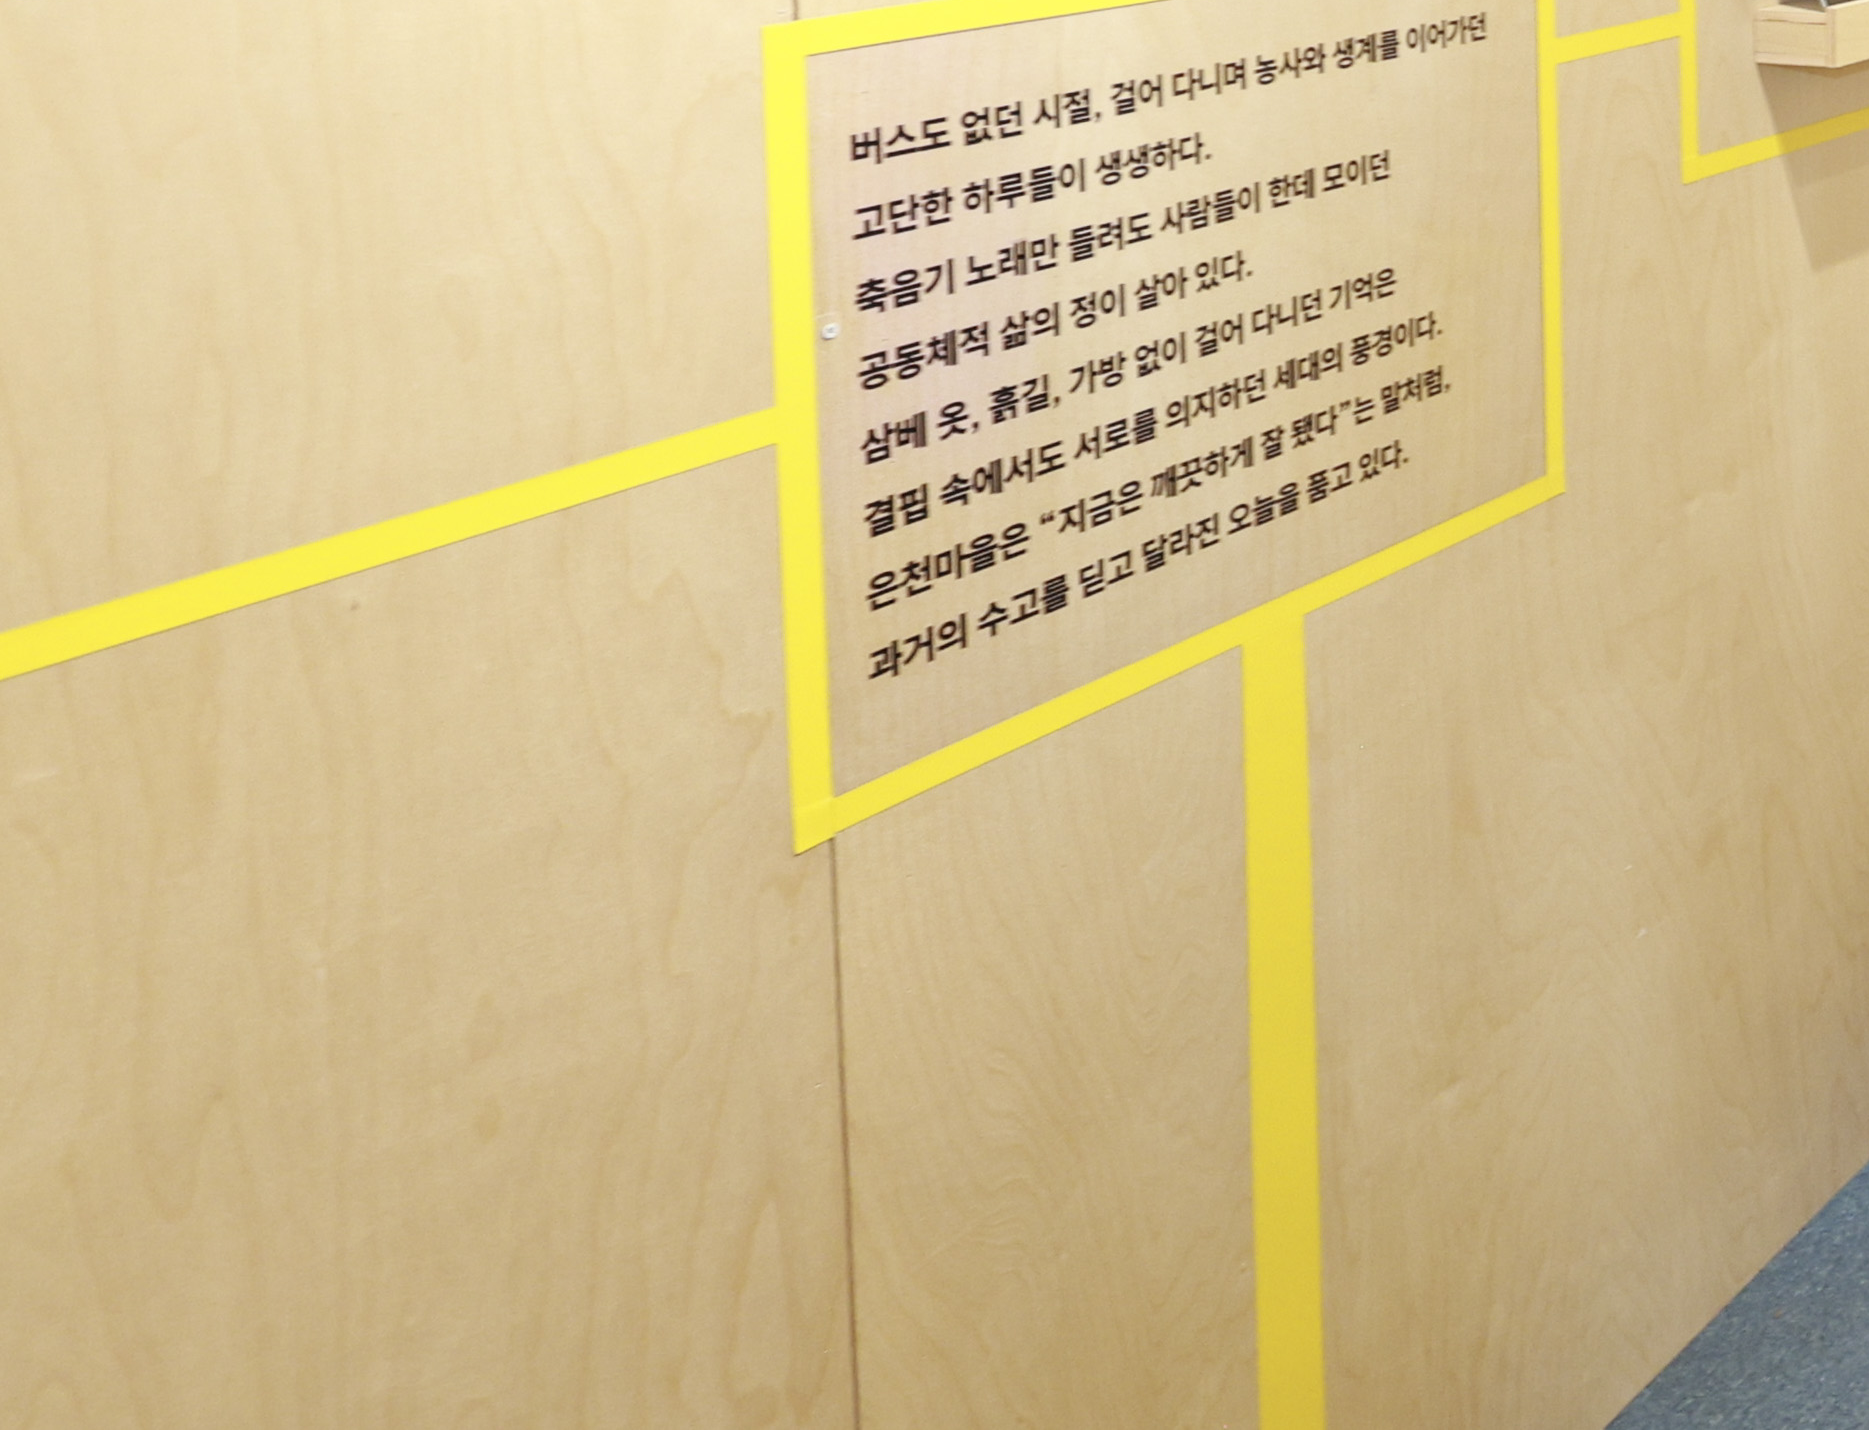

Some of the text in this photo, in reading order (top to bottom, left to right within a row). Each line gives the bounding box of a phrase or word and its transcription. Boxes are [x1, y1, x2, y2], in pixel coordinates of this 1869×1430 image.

[850, 12, 1488, 164] 버스도 없던 시절, 걸어 다니며 농사와 생계를 이어가던
[852, 133, 1212, 241] 고단한 하루들이 생생하다.
[855, 150, 1391, 313] 축음기 노래만 들려도 사람들이 한데 모이던
[858, 250, 1253, 391] 공동체적 삶의 정이 살아 있다.
[860, 267, 1398, 464] 삼베 옷, 흙길, 가방 없이 걸어 다니던 기억은
[864, 311, 1443, 537] 결핍 속에서도 서로를 의지하던 세대의 풍경이다.
[866, 366, 1451, 611] 은천마을은 “지금은 깨끗하게 잘 됐다”는 말처럼,
[868, 440, 1409, 679] 과거의 수고를 딛고 달라진 오늘을 품고 있다.
